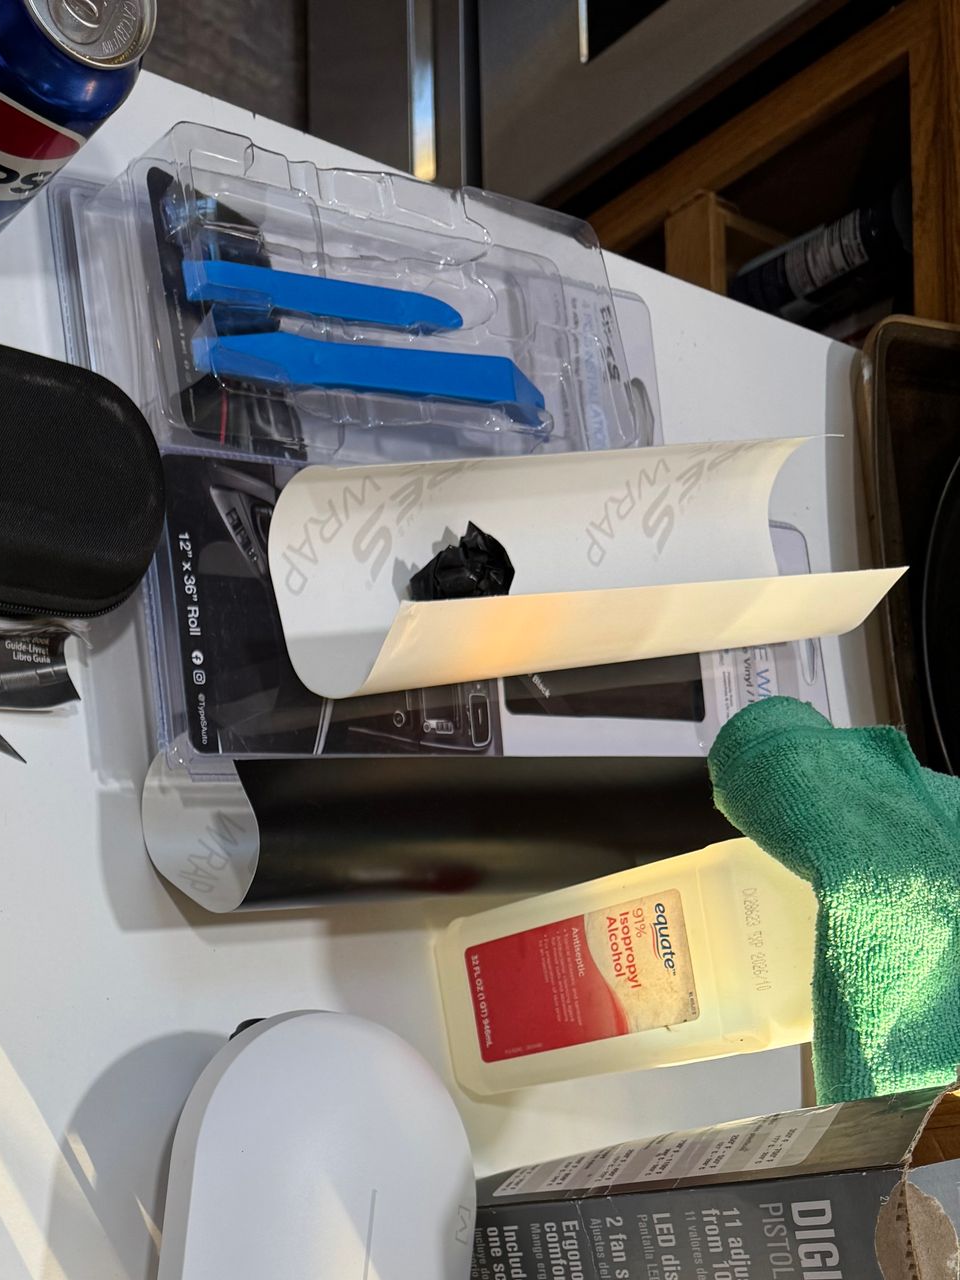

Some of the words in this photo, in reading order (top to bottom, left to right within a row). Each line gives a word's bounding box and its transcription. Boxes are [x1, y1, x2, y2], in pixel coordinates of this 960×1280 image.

[586, 457, 672, 567] WRAP
[285, 473, 382, 596] WRAP
[181, 560, 190, 570] x
[186, 605, 201, 636] Roll
[741, 657, 754, 687] Vinyl
[631, 907, 647, 938] 91%
[470, 954, 479, 966] 32
[570, 927, 586, 977] Antiseptic
[606, 915, 625, 977] Alcohol
[617, 911, 641, 989] Isopropyl
[473, 965, 481, 978] FL
[475, 978, 484, 992] OZ
[481, 1017, 492, 1047] 946mL
[605, 1214, 623, 1228] 2
[652, 1210, 676, 1249] LED
[683, 1209, 696, 1222] 11
[700, 1207, 725, 1253] from
[721, 1206, 742, 1229] 11
[485, 1225, 502, 1257] one
[527, 1222, 545, 1259] Mango
[587, 1216, 608, 1259] Ajustes
[608, 1231, 630, 1263] fan
[636, 1213, 656, 1260] Pantalla
[687, 1224, 705, 1265] valores
[597, 1260, 611, 1280] del
[695, 1266, 708, 1280] de
